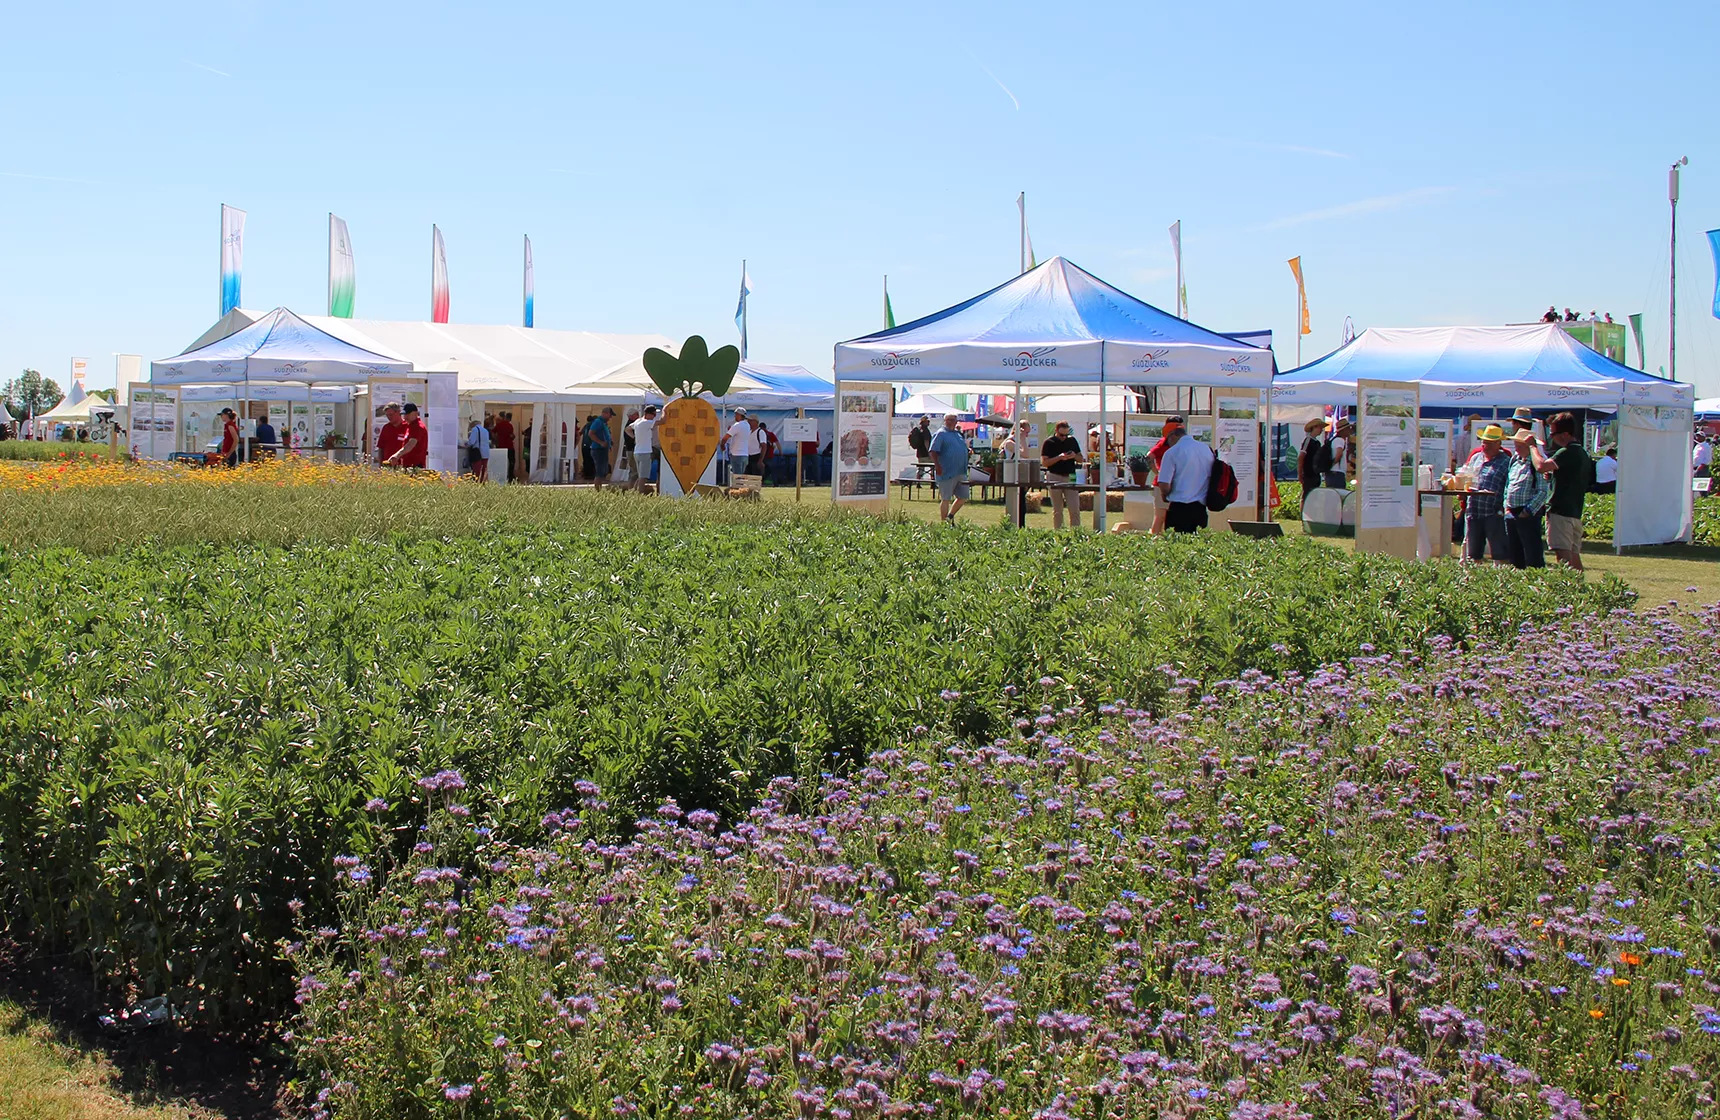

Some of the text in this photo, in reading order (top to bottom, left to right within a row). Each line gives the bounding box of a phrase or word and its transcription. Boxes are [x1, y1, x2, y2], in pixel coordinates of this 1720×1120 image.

[870, 357, 921, 366] SÜDZUCKER
[1002, 357, 1057, 367] SÜDZUCKER
[1131, 359, 1169, 369] SÜDZUCKER
[1220, 362, 1252, 373] SÜDZUCKER
